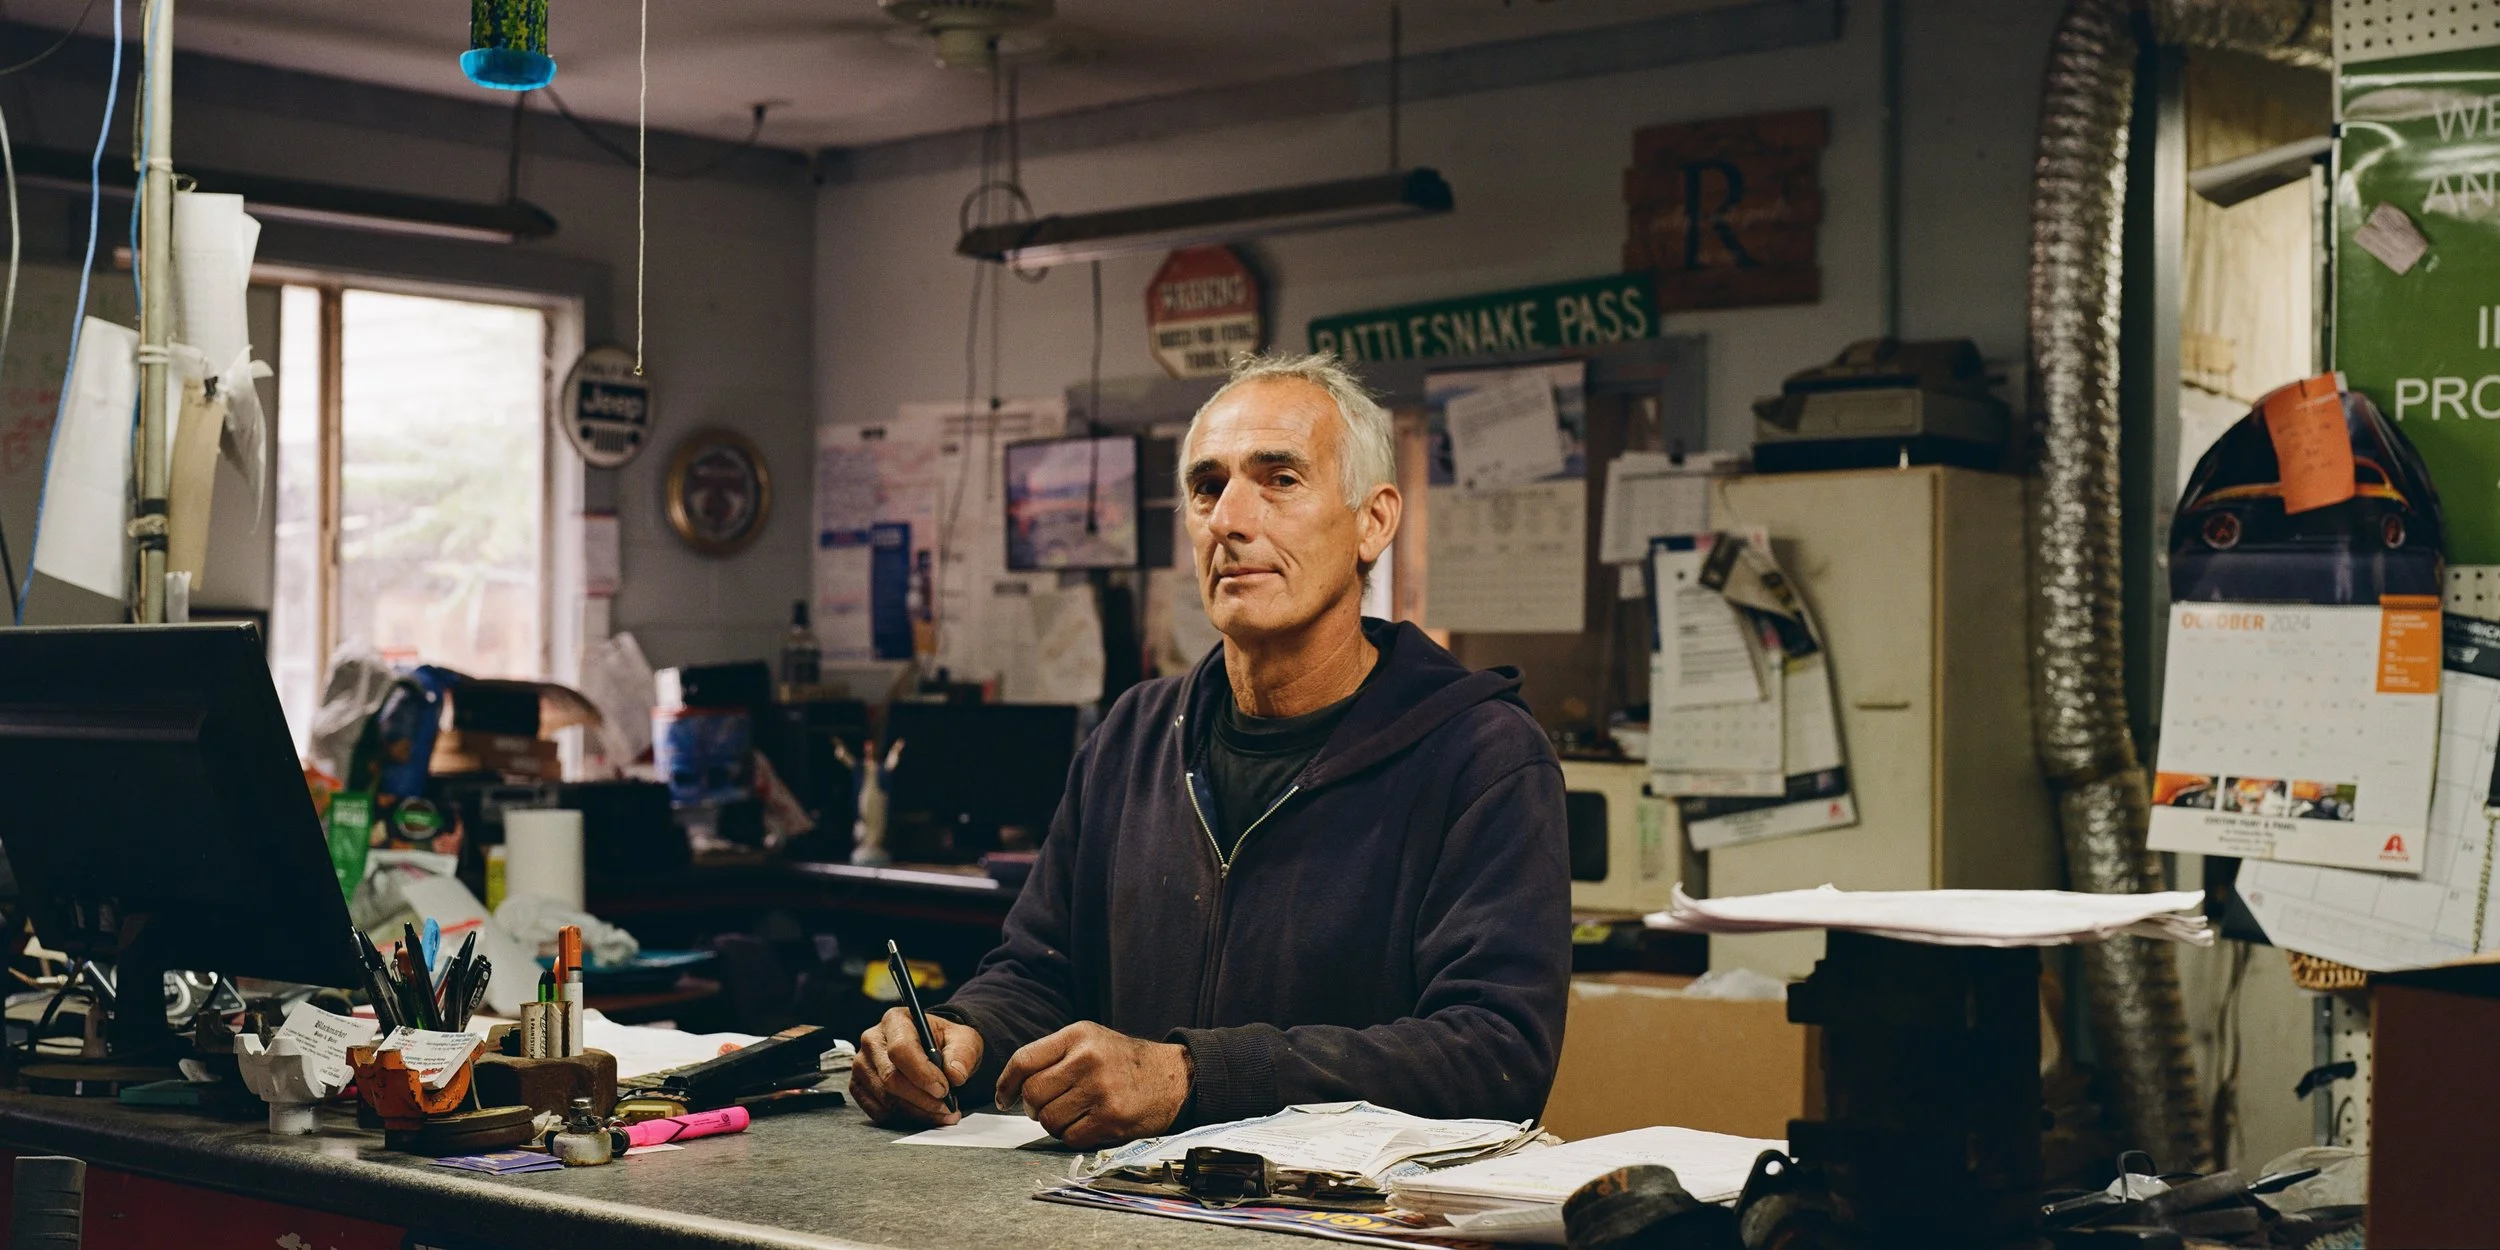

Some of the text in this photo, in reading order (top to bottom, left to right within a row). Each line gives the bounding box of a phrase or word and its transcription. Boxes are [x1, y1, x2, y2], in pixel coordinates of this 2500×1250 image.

[1682, 157, 1760, 270] R
[1556, 287, 1647, 348] PASS
[583, 382, 643, 419] Jeep
[2181, 611, 2311, 633] OCOBER 2024
